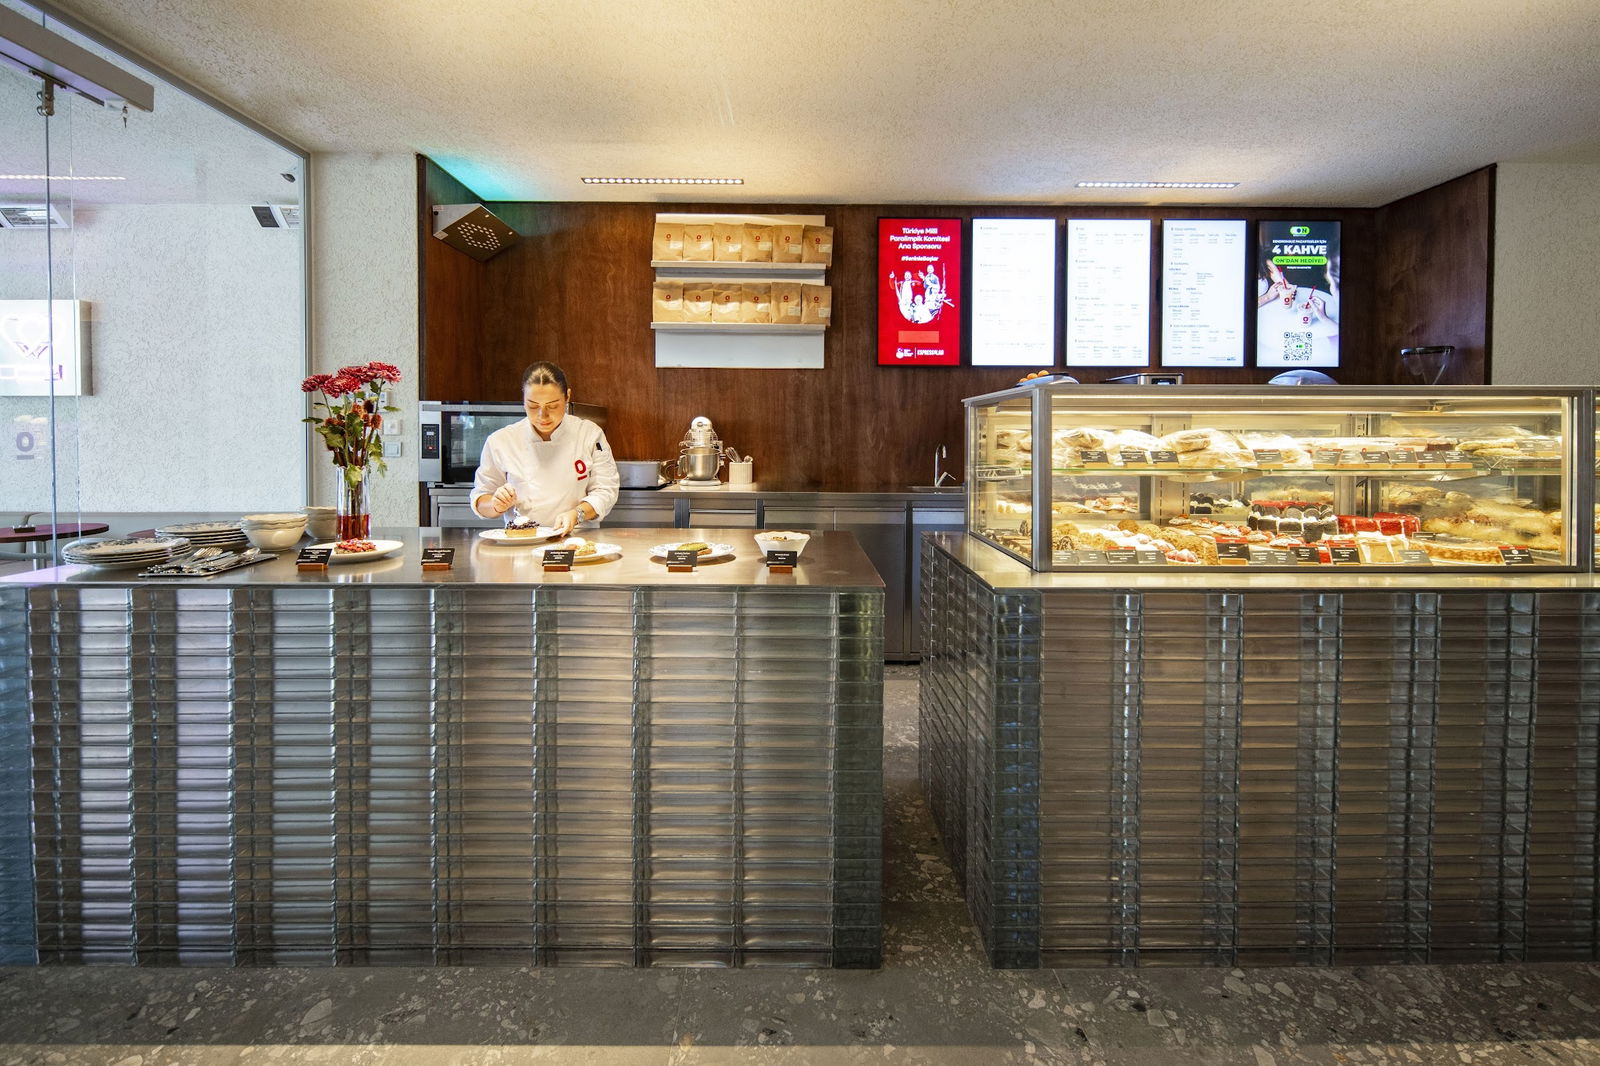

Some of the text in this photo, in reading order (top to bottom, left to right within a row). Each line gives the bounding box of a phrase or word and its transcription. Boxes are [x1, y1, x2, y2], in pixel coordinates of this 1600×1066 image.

[902, 227, 924, 235] Türkiye
[890, 235, 924, 243] Paralimpik
[1272, 245, 1327, 254] 4 KAHVE
